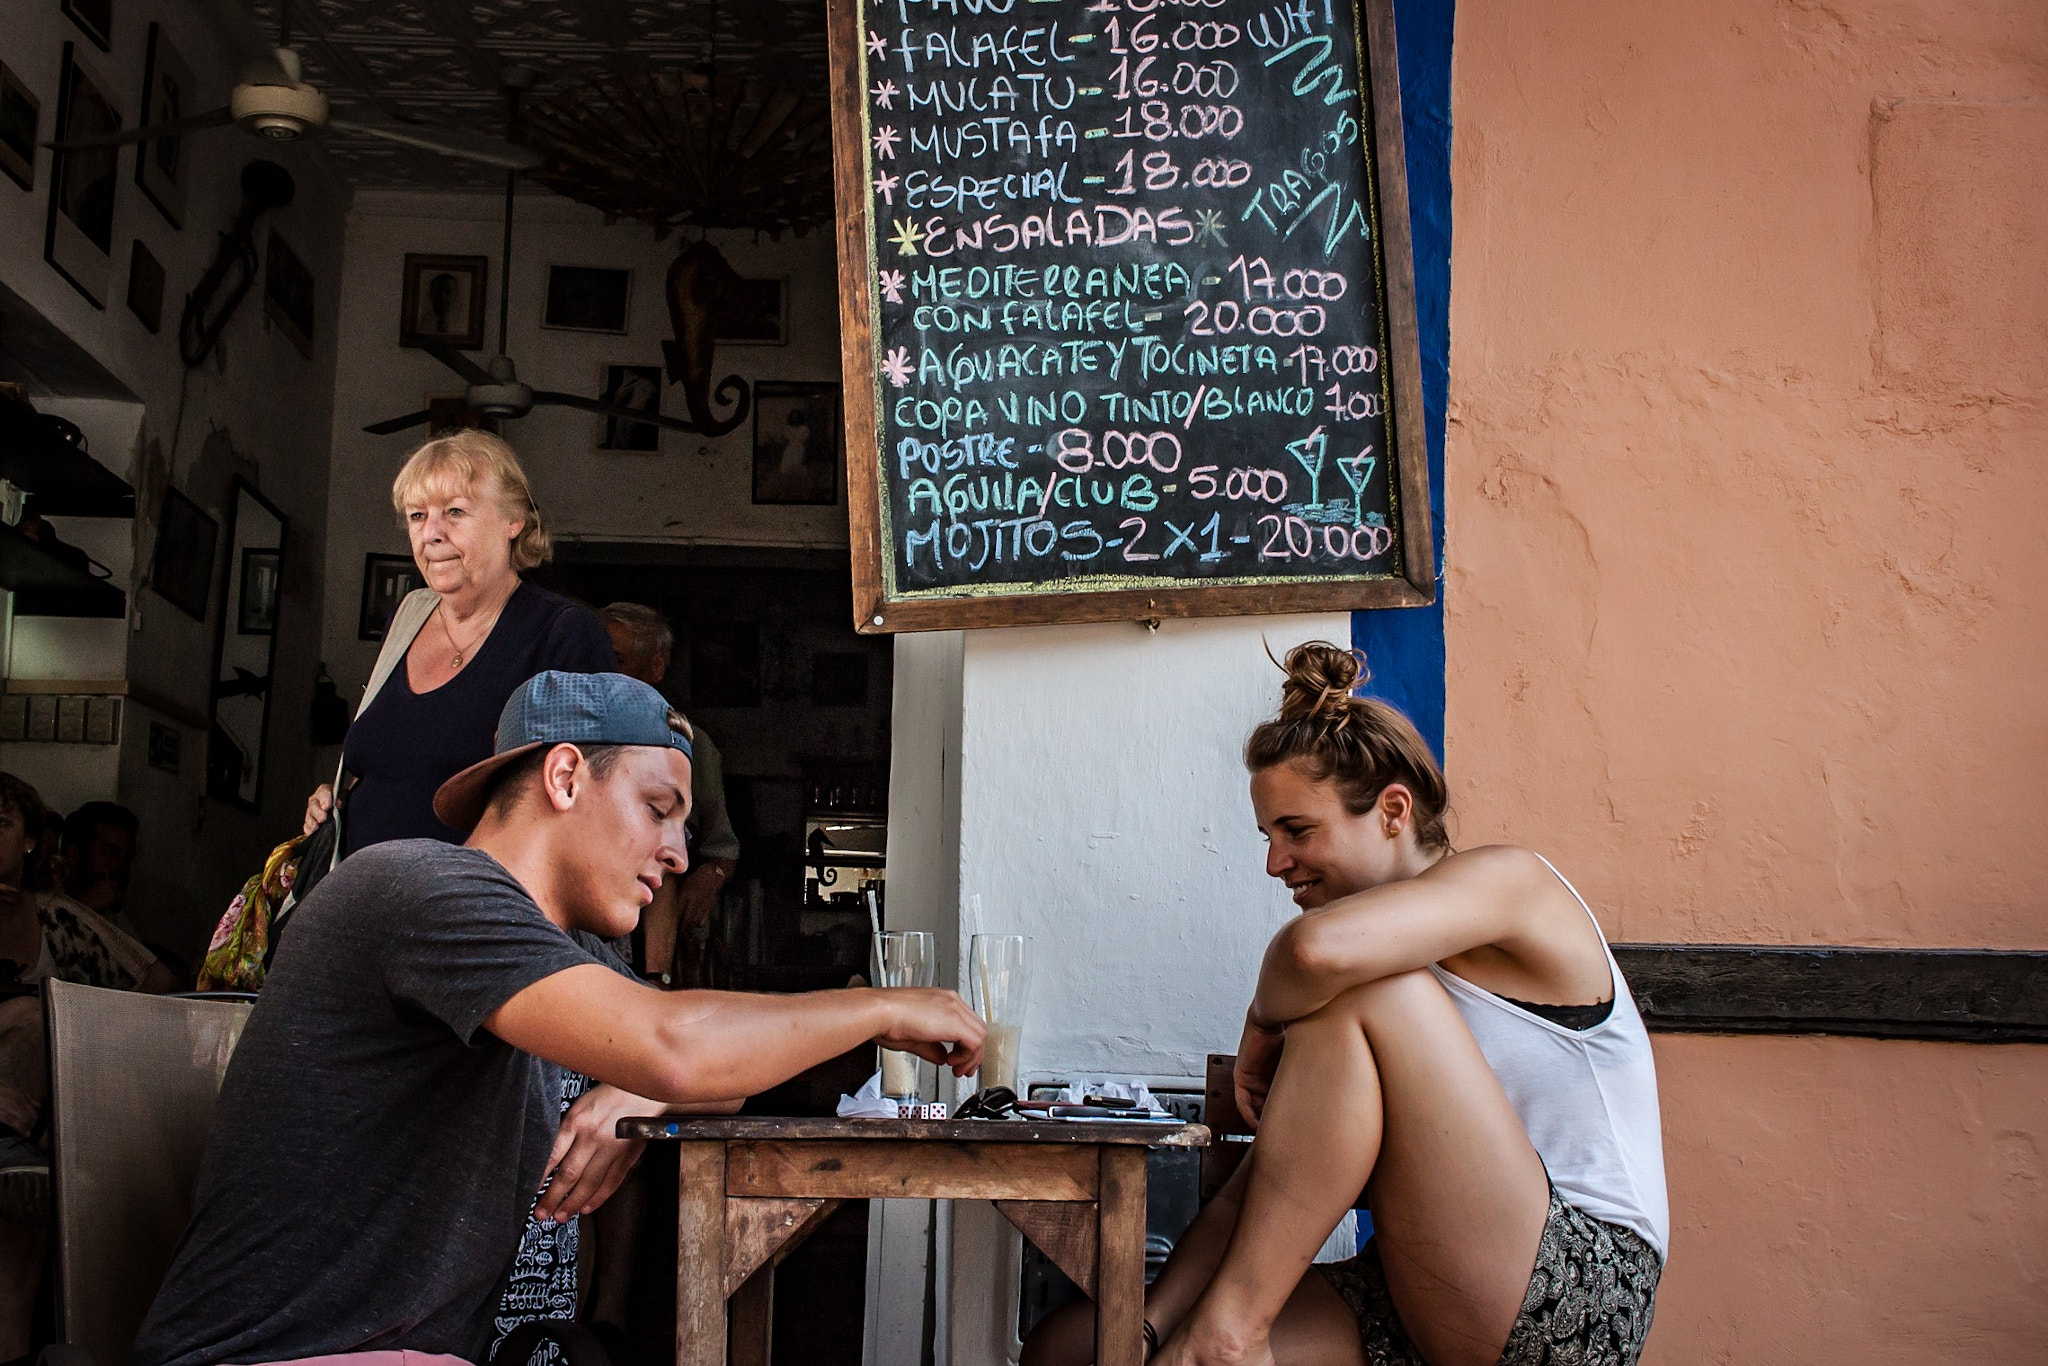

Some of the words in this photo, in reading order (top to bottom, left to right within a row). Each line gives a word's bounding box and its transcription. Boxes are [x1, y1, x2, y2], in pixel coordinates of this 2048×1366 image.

[1104, 13, 1241, 54] 16.000
[1108, 56, 1240, 100] 16.000
[910, 115, 1077, 164] MUSTAFA
[1113, 100, 1244, 141] 18.000
[905, 162, 1083, 214] ESPECIAL
[1105, 148, 1251, 195] 18.000
[923, 205, 1195, 258] ENSALADAS
[912, 263, 1191, 303] MEDITERRANEA
[913, 305, 992, 333] CON
[1184, 300, 1326, 337] 20.000
[1131, 335, 1278, 381] TOCINETA
[1289, 343, 1378, 387] 17.000
[895, 396, 990, 440] COPA
[998, 390, 1087, 426] VINO
[897, 432, 1019, 480] POSTRE
[1188, 465, 1288, 503] 5.000
[906, 518, 1103, 571] MOJITOS
